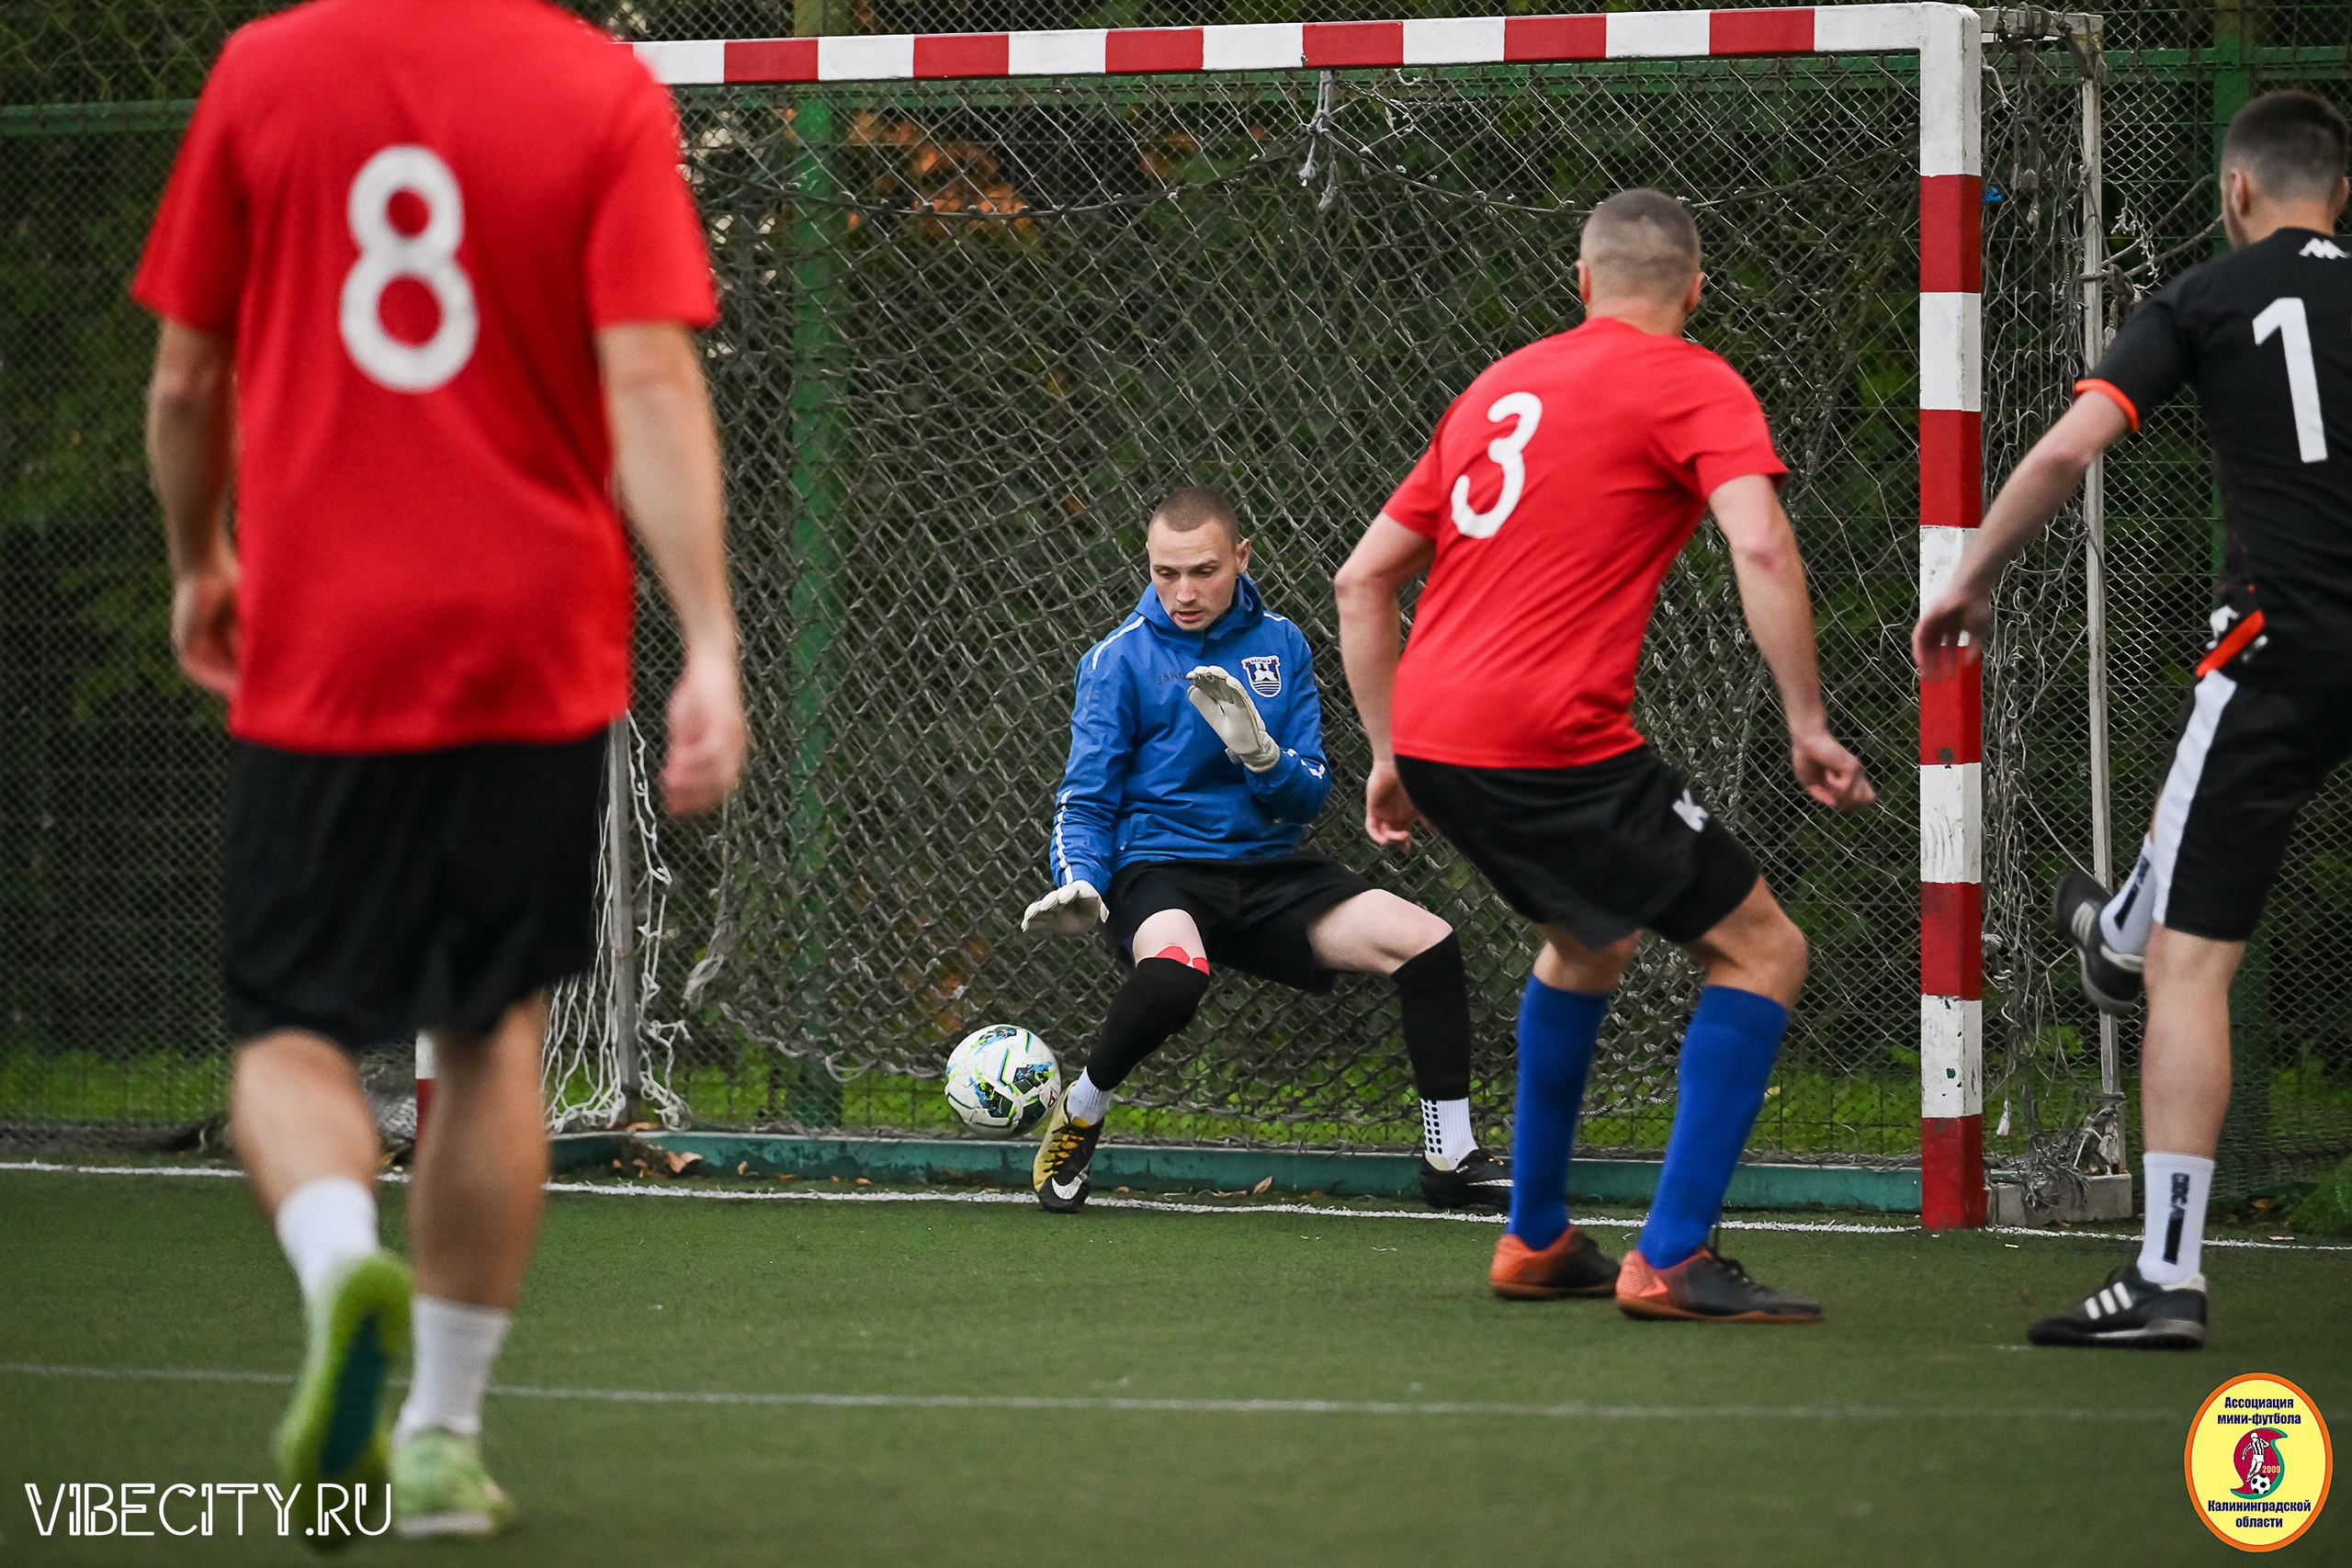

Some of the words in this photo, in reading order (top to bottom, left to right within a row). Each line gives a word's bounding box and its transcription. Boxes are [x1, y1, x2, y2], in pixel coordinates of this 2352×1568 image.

[337, 142, 481, 394] 8
[2252, 297, 2328, 463] 1
[1451, 391, 1544, 539] 3
